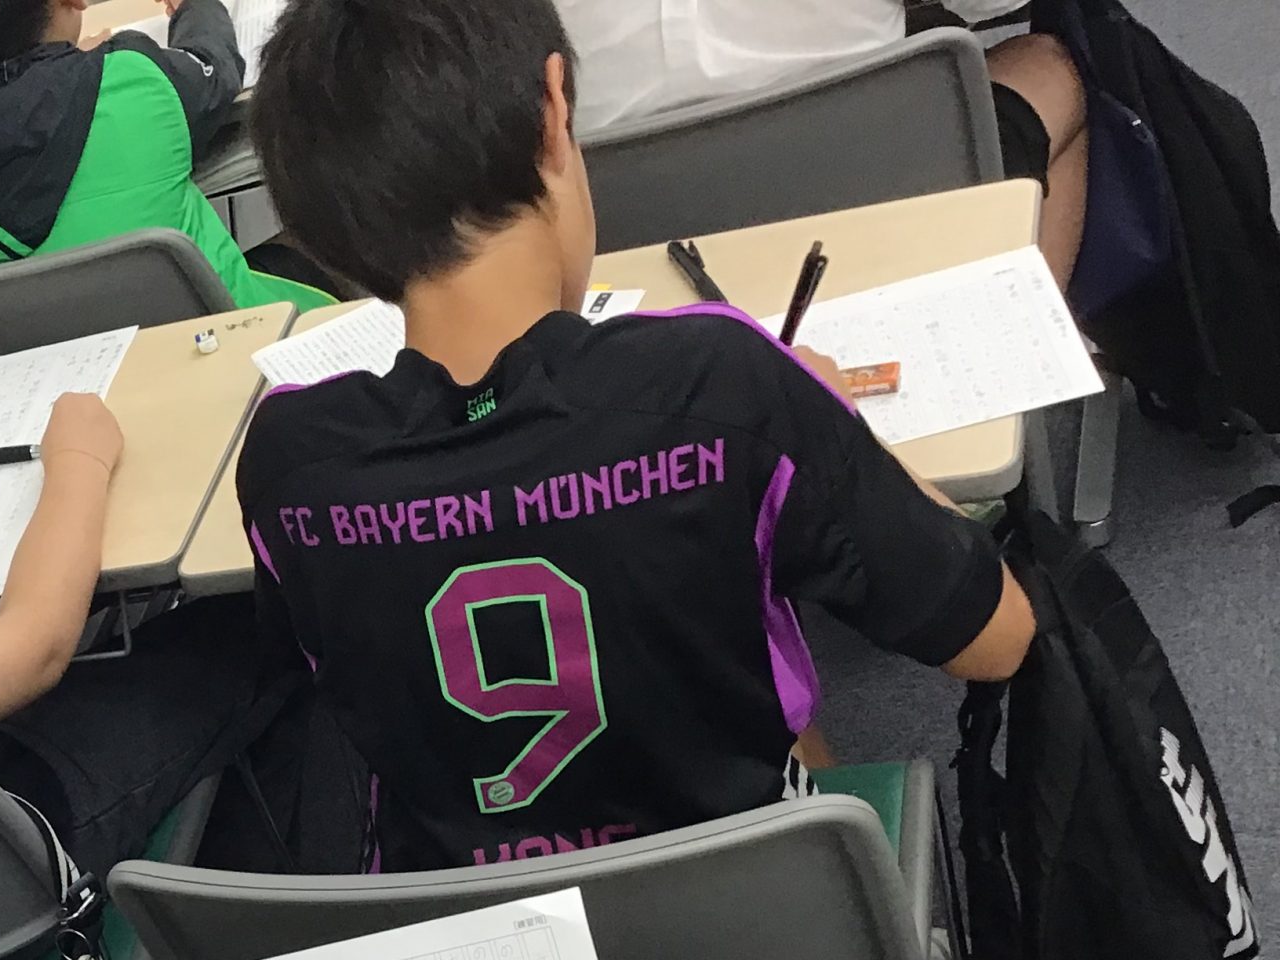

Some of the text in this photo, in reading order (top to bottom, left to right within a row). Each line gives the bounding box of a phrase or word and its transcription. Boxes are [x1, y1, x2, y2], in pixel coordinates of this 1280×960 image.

[467, 398, 496, 422] SAN
[280, 438, 725, 547] FC BAYERN MÜNCHEN
[425, 557, 608, 813] 9
